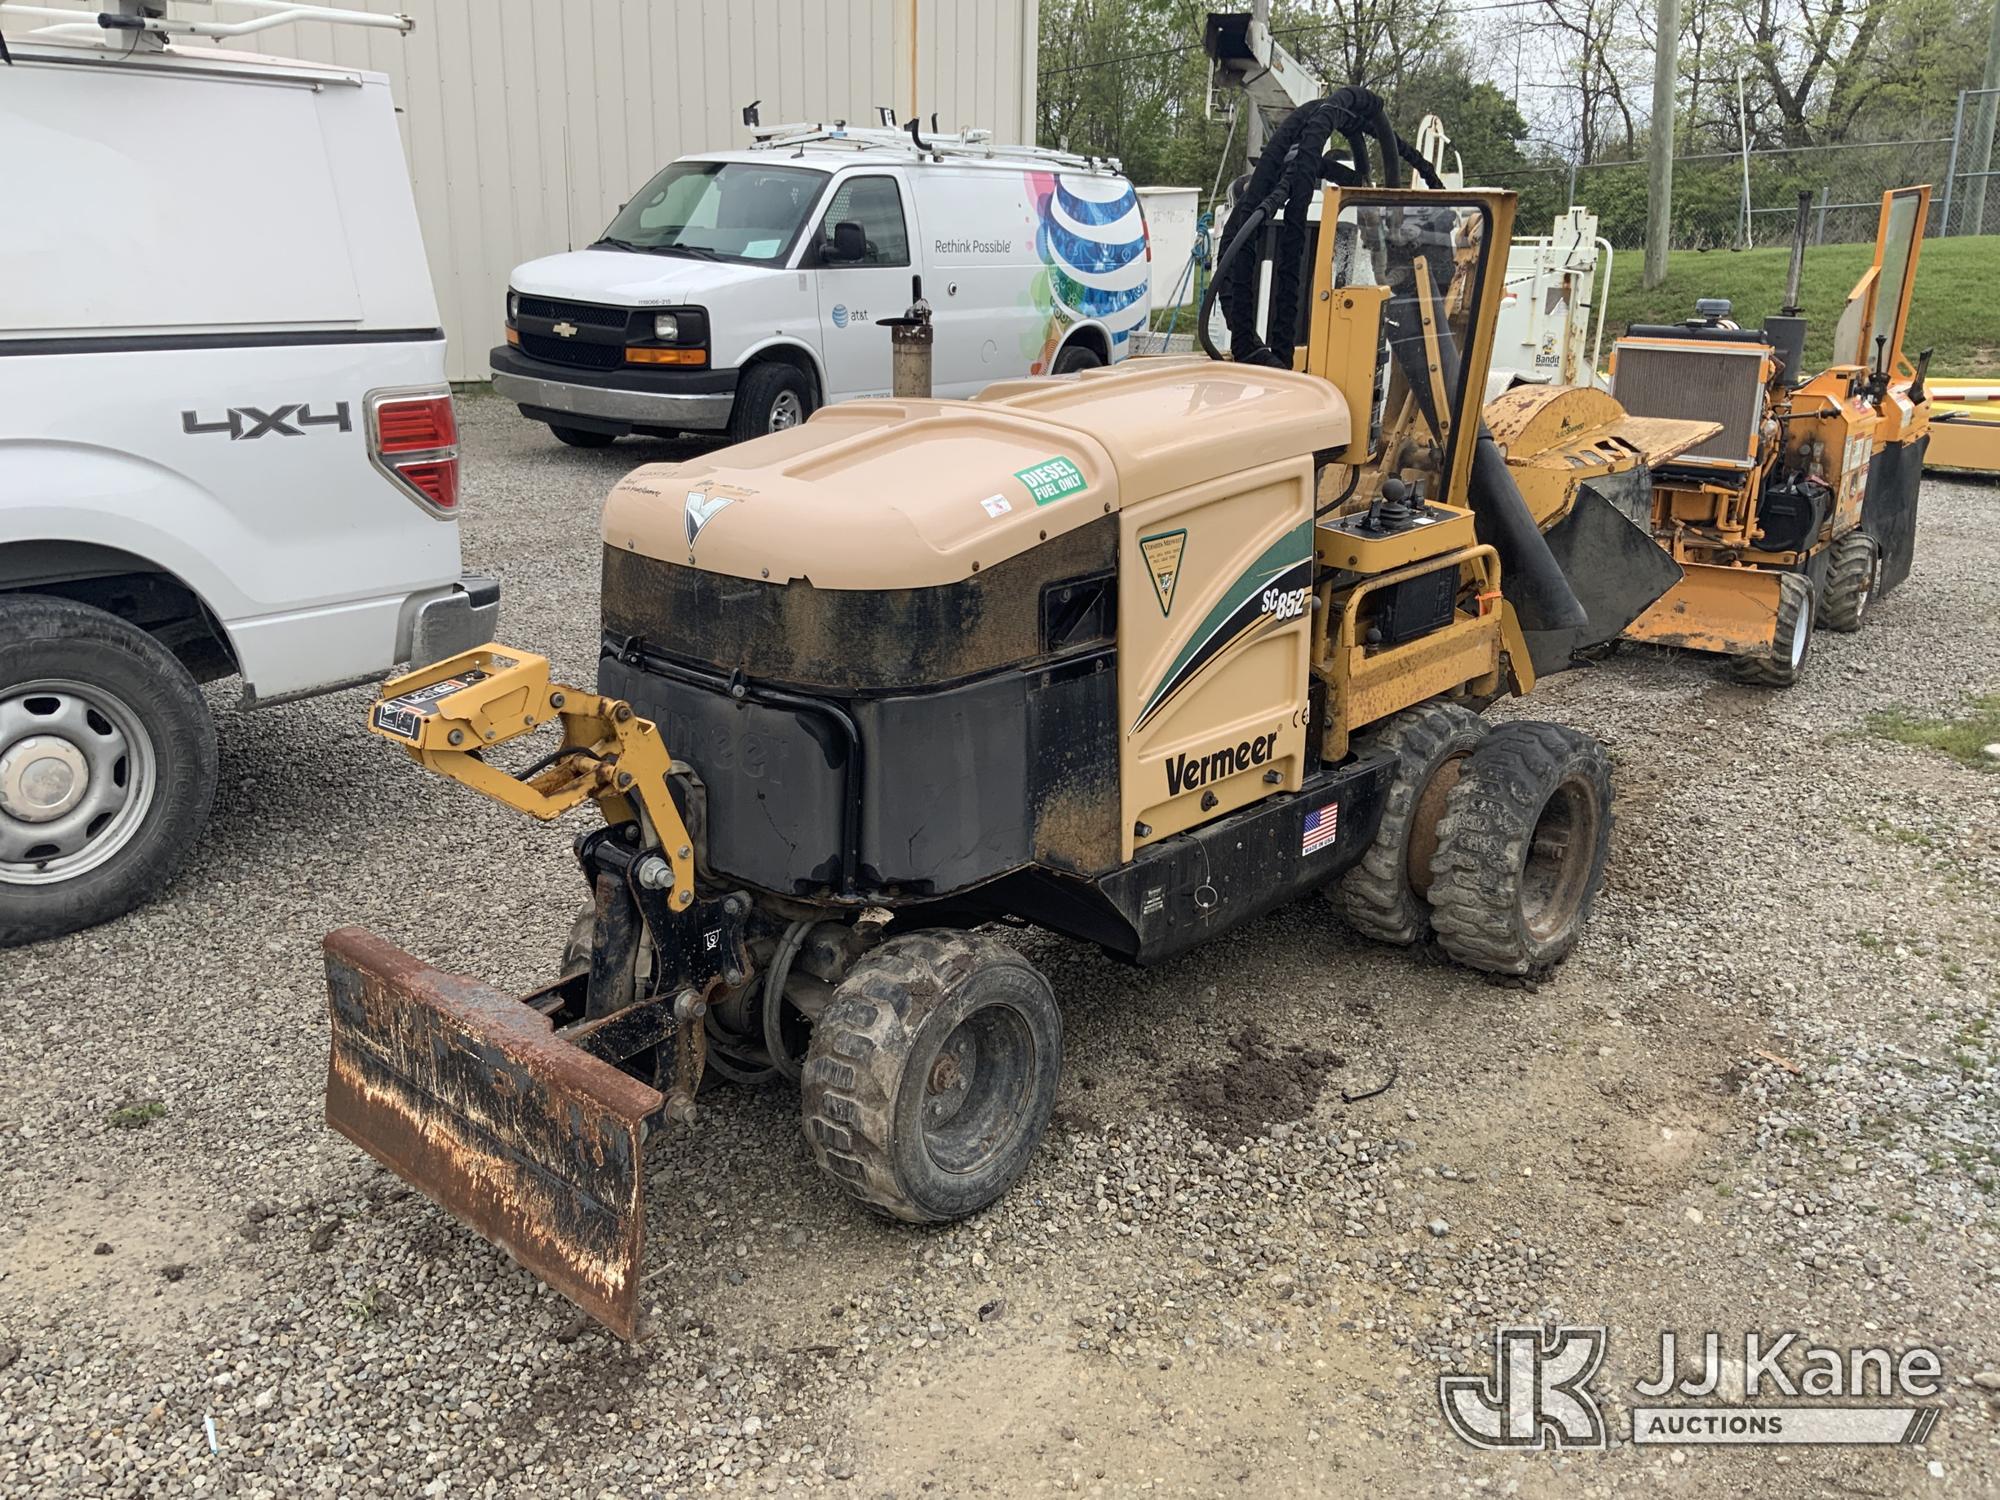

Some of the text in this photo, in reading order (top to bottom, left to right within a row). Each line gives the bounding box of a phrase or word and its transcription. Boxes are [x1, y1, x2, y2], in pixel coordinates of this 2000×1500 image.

[935, 239, 1010, 253] Rethink Possible
[850, 309, 869, 321] at&t
[1535, 354, 1560, 364] Bandit
[1020, 460, 1076, 488] DIESEL
[1033, 473, 1082, 501] FUEL ONLY
[1165, 731, 1278, 797] Vermeer
